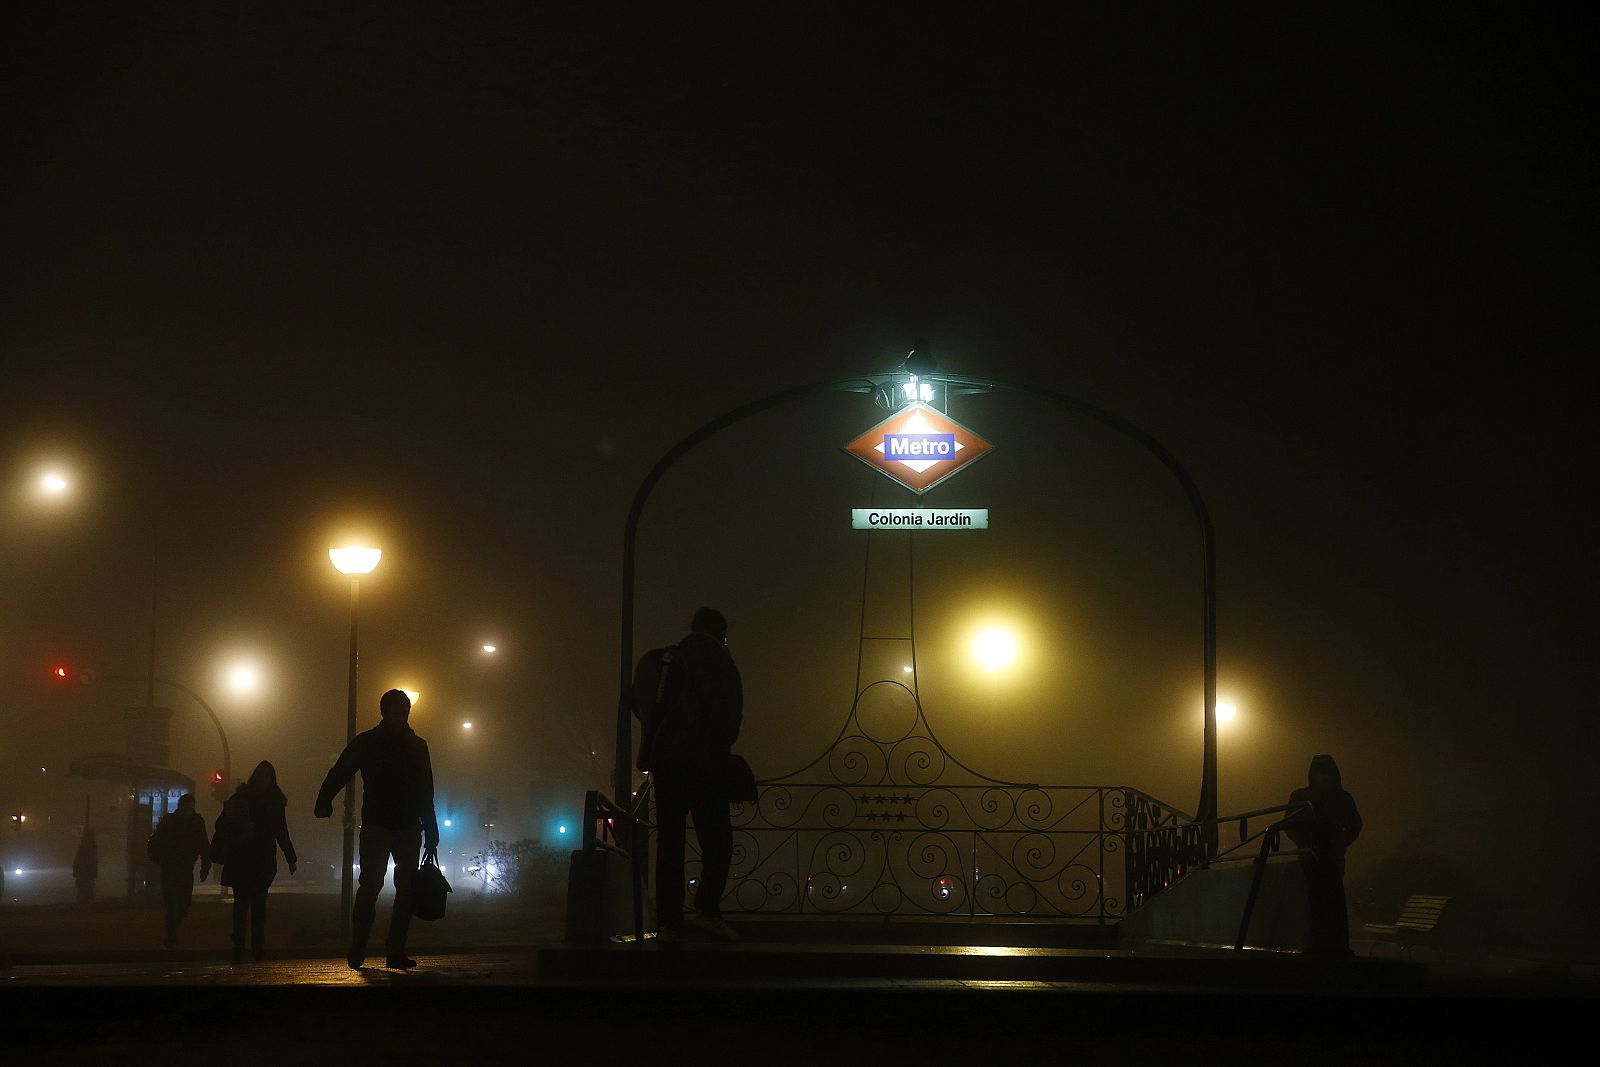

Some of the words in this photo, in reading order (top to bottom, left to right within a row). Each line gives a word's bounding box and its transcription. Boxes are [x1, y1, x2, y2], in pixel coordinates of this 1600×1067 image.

[890, 437, 950, 456] Metro
[868, 512, 923, 526] Colonia
[927, 512, 972, 526] Jardín
